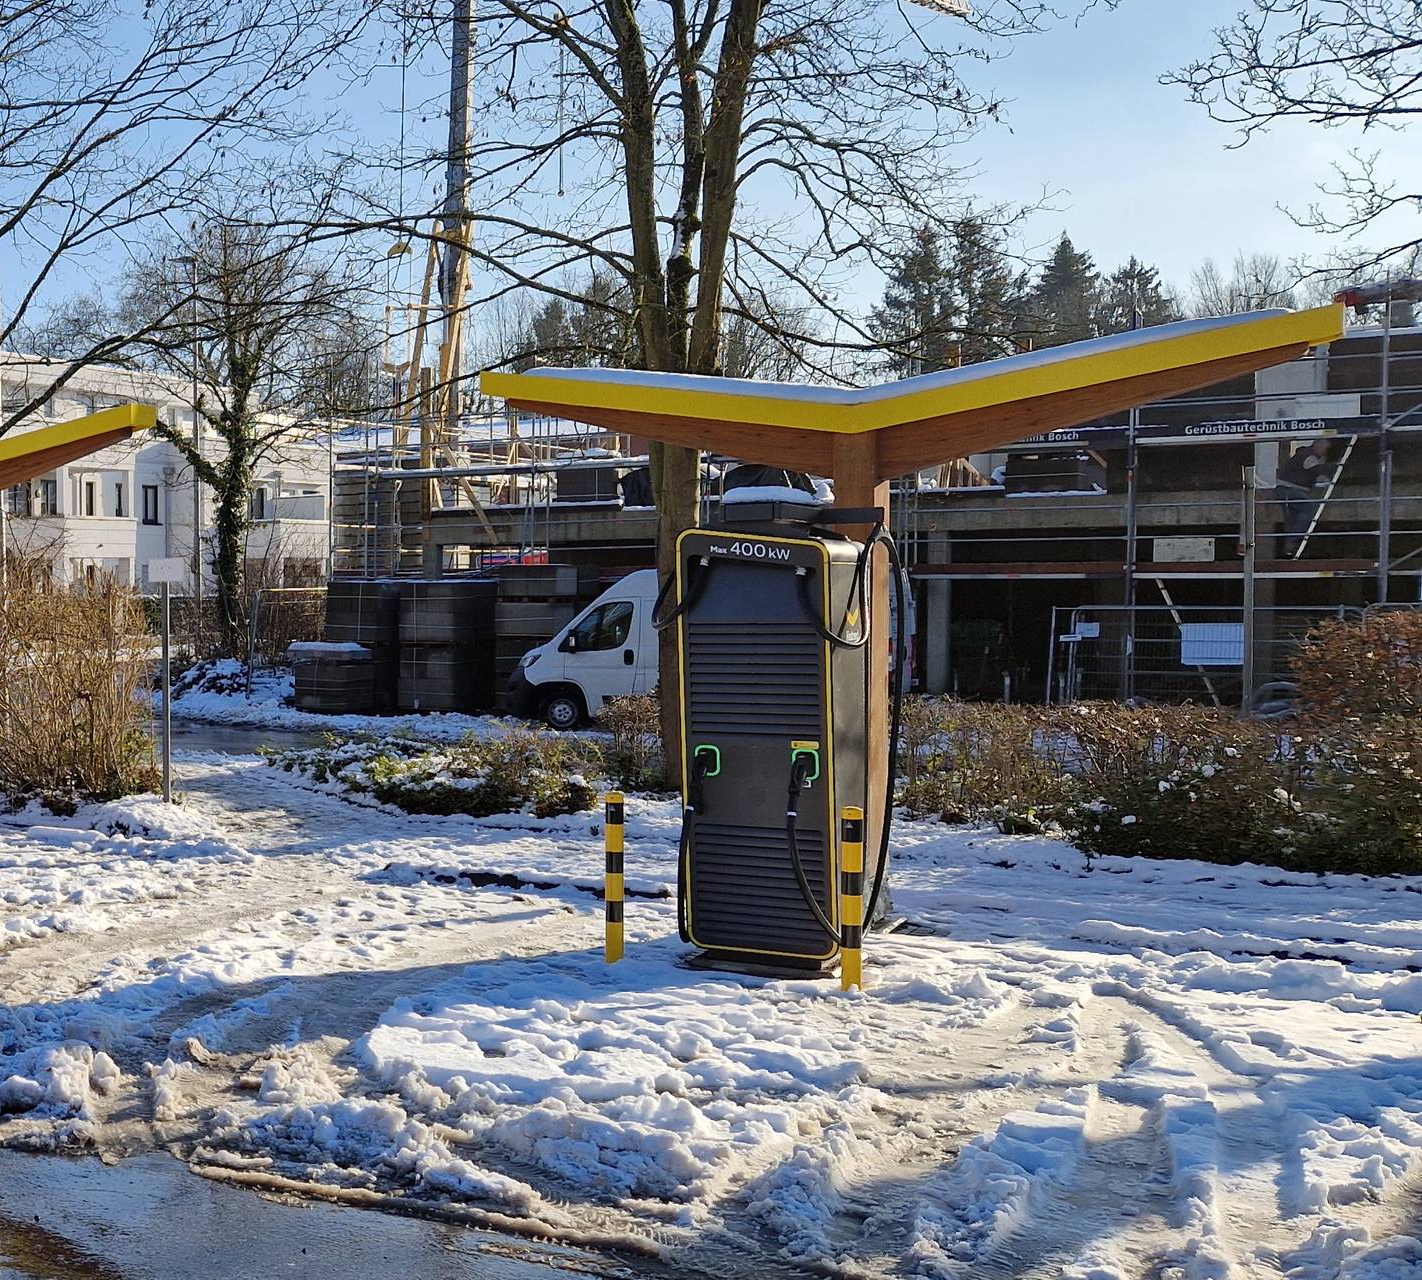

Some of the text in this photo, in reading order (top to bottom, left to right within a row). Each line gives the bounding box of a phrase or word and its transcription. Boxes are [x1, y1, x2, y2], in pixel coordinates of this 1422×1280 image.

[1184, 419, 1326, 435] Gerüstbautechnik Bosch
[1048, 431, 1079, 441] Bosch
[710, 541, 790, 560] Max 400 kW
